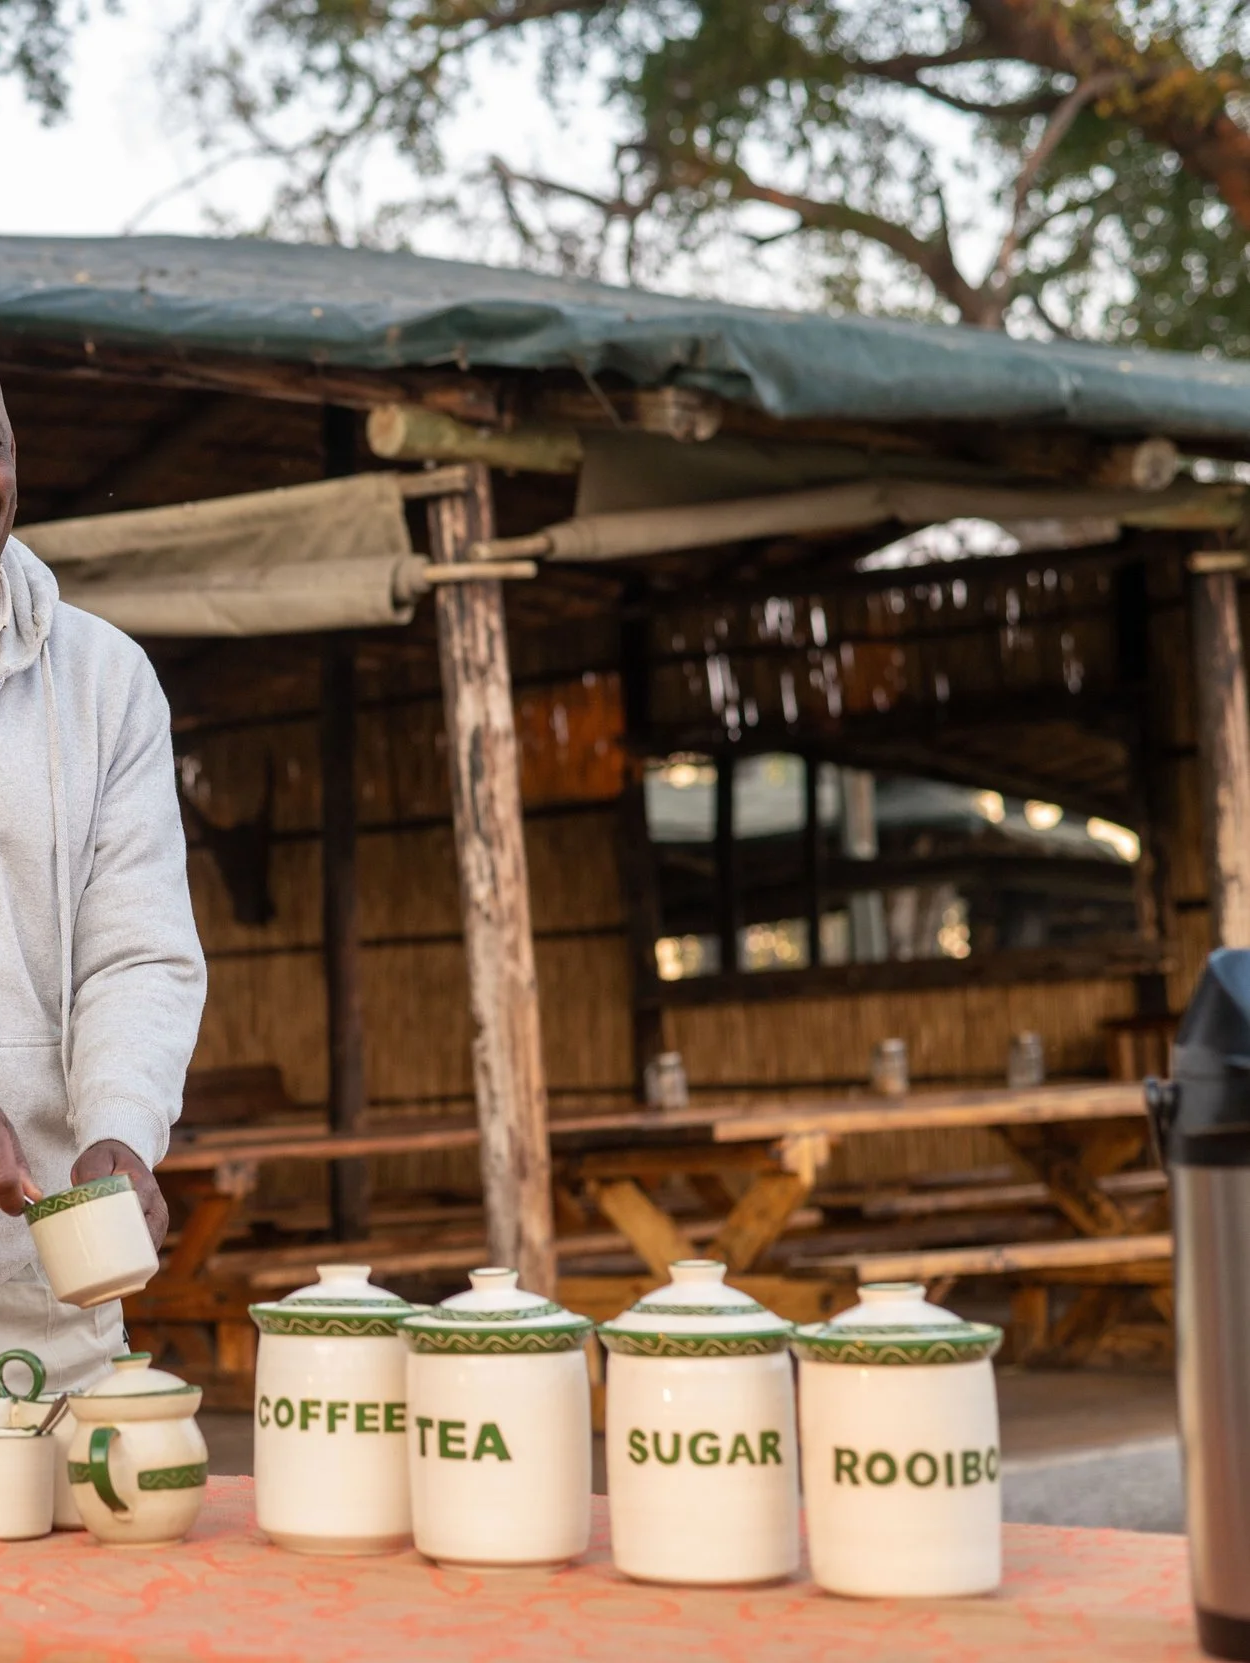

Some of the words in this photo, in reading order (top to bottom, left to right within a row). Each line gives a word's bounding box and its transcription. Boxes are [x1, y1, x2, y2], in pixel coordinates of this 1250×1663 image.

[257, 1395, 407, 1433] COFFEE
[416, 1417, 512, 1461] TEA
[628, 1428, 783, 1465] SUGAR
